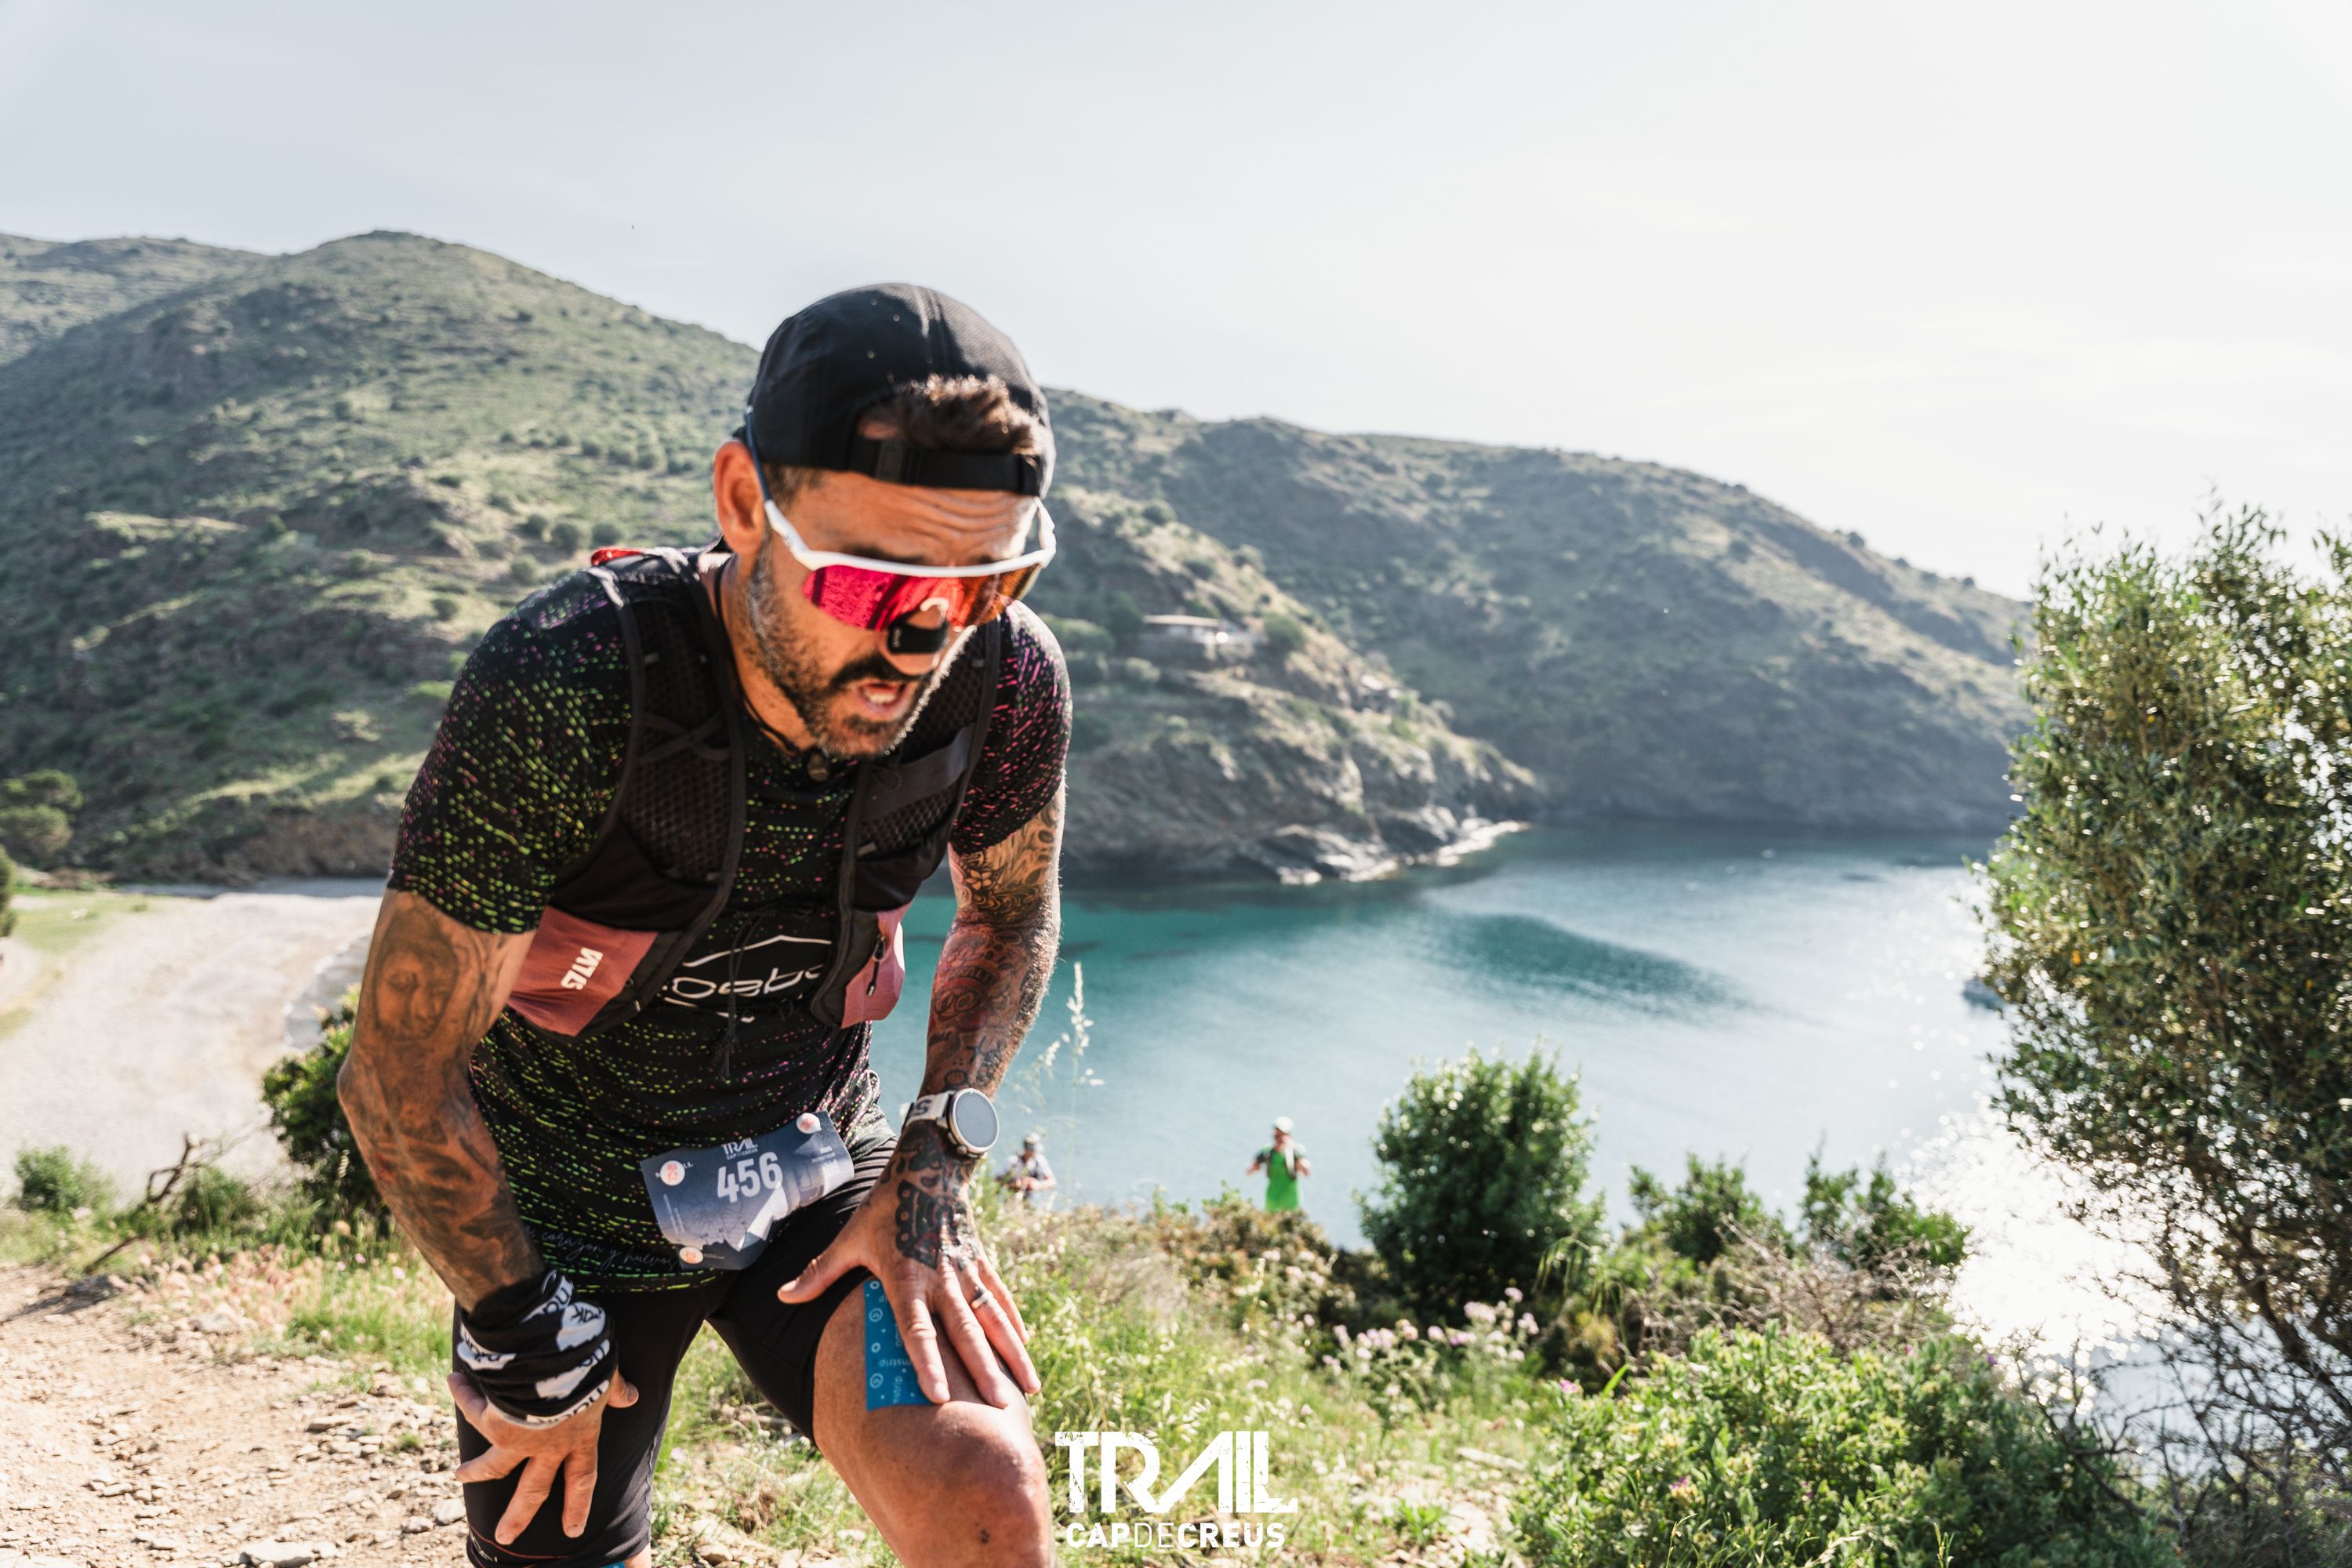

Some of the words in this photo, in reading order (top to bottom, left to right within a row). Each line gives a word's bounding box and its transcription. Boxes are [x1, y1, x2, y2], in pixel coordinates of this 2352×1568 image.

[721, 1137, 759, 1155] TRAIL
[717, 1151, 783, 1203] 456
[878, 1357, 913, 1368] mstrip
